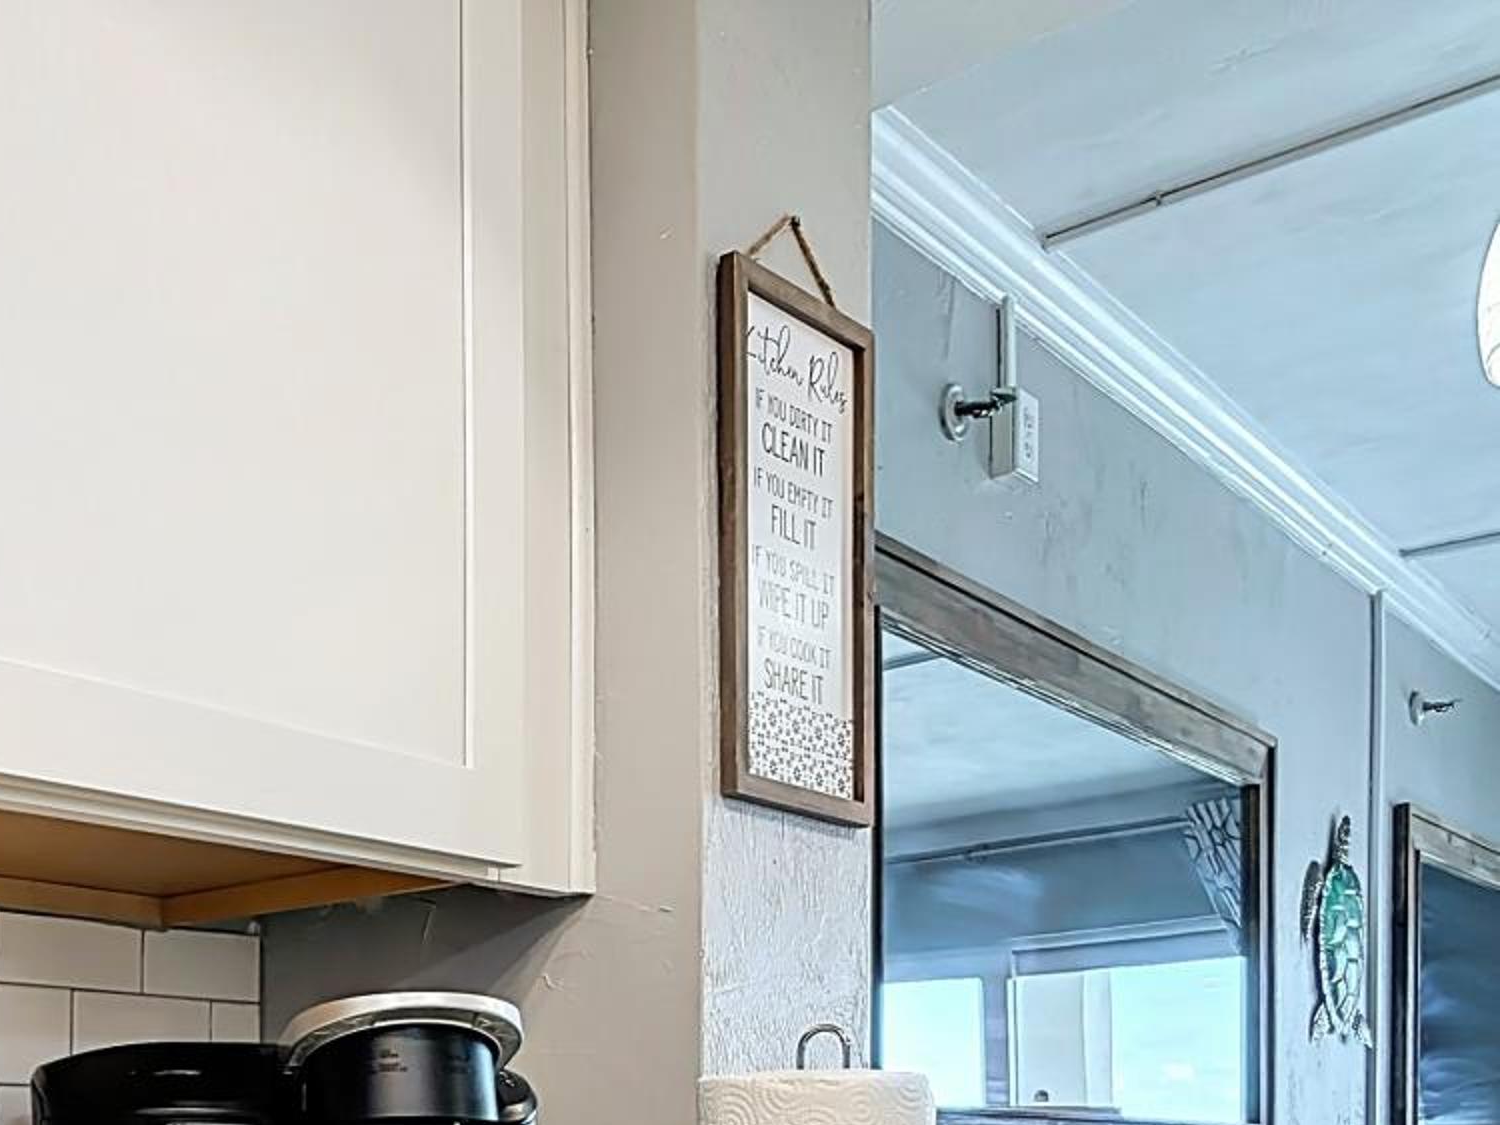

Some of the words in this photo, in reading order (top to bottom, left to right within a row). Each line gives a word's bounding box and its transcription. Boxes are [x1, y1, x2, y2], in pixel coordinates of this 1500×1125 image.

[807, 351, 848, 414] Rules
[755, 387, 765, 409] IF
[767, 394, 787, 421] YOU
[821, 420, 833, 444] IT
[761, 422, 808, 470] CLEAN
[813, 445, 825, 477] IT
[753, 466, 762, 488] IF
[765, 471, 785, 499] YOU
[821, 496, 834, 519] IT
[771, 503, 801, 545] FILL
[803, 518, 816, 551] IT
[796, 592, 806, 625] IT
[811, 598, 829, 632] UP
[764, 657, 808, 701] SHARE
[812, 674, 824, 705] IT
[819, 647, 831, 670] IT
